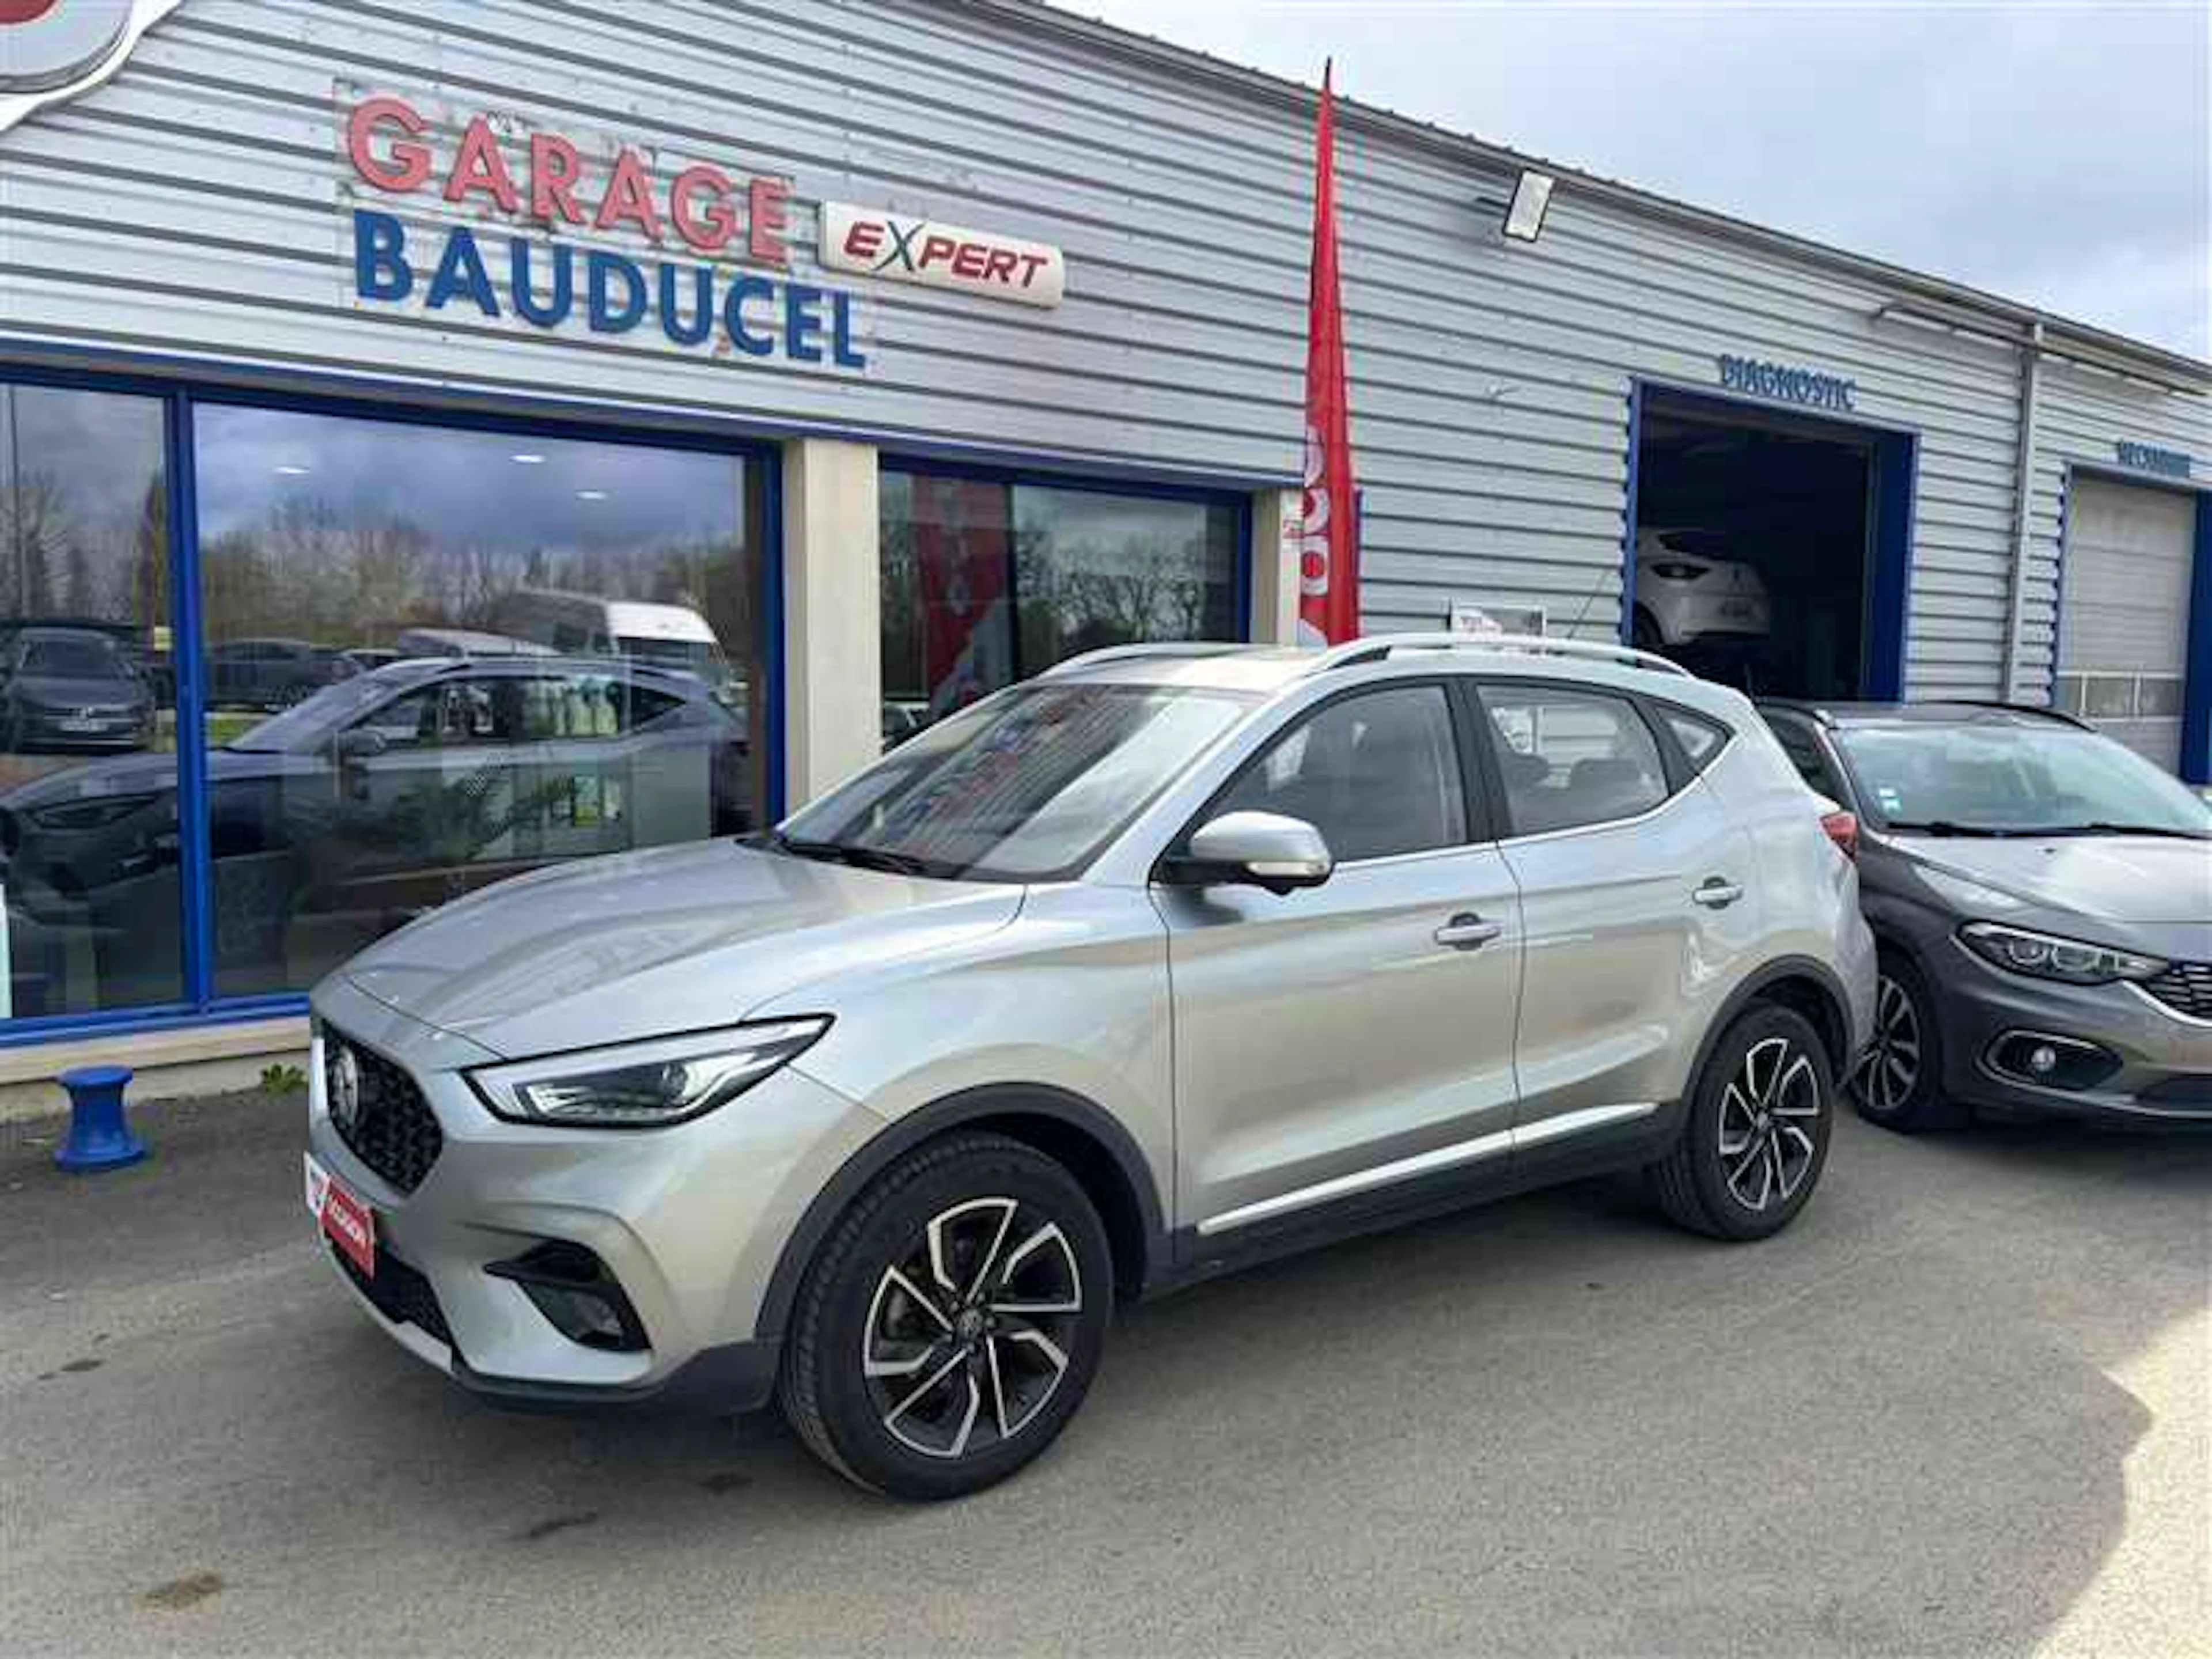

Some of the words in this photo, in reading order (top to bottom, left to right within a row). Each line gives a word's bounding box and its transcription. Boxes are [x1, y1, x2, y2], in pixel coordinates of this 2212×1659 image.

[347, 99, 790, 265] GARAGE
[353, 210, 866, 368] BAUDUCEL
[843, 220, 1048, 288] EXPERT
[1721, 354, 1857, 411] DIAGNOSTIC
